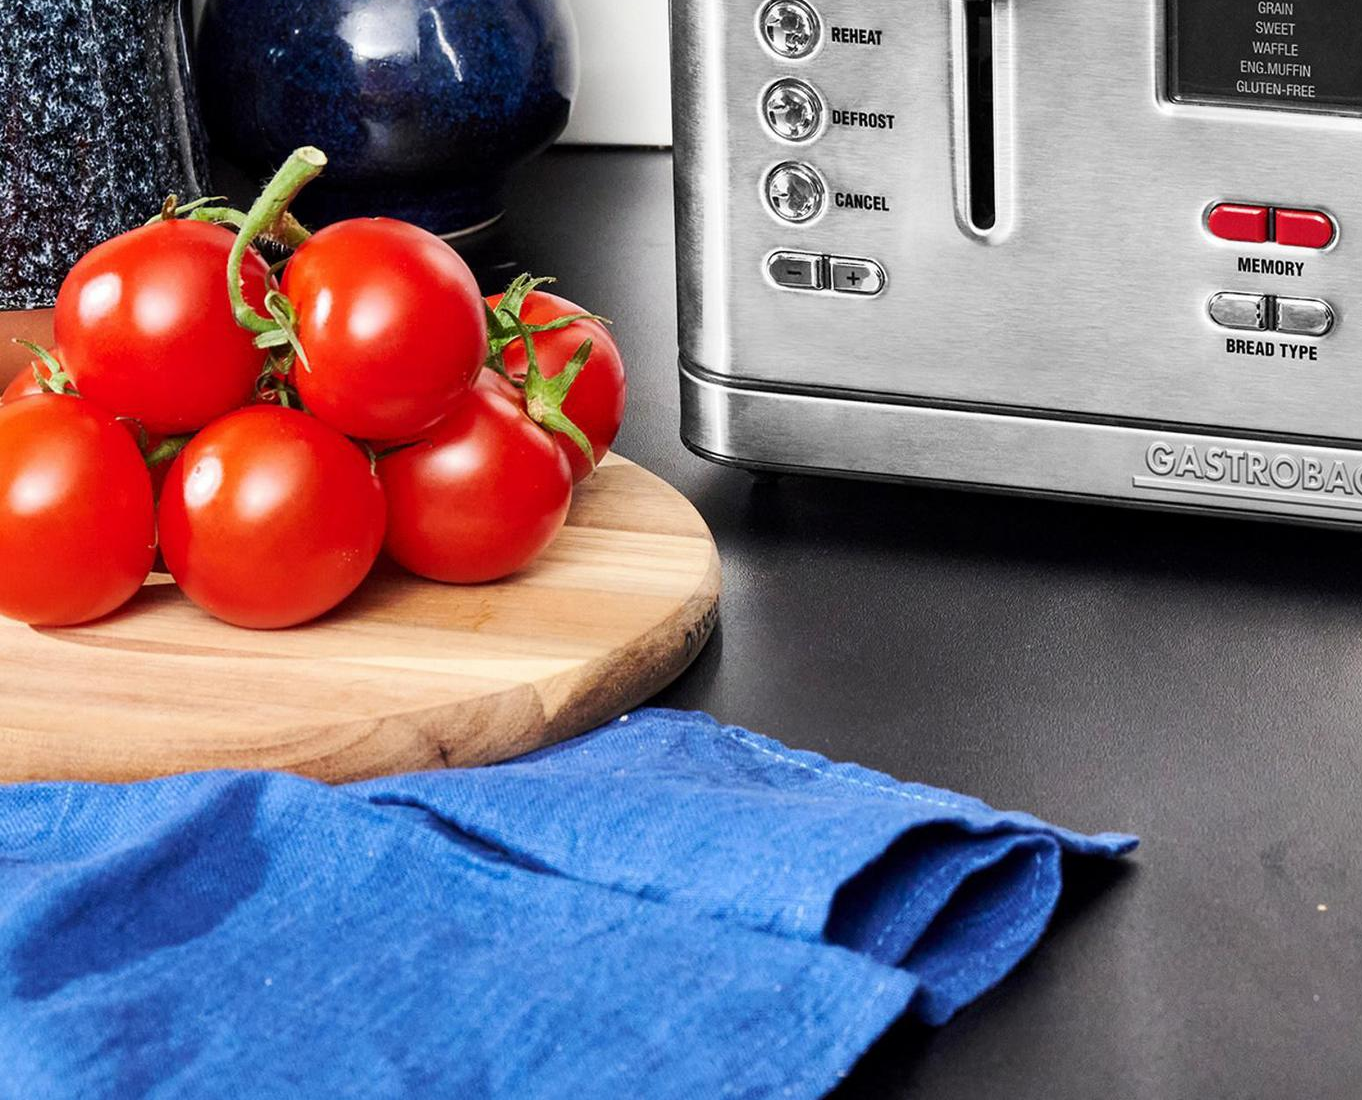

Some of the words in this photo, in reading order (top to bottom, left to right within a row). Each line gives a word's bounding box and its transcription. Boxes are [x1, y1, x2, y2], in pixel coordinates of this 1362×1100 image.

[1257, 1, 1293, 16] GRAIN
[831, 26, 883, 45] REHEAT
[1255, 21, 1296, 36] SWEET
[1252, 41, 1299, 57] WAFFLE
[1240, 60, 1311, 78] ENG.MUFFIN
[1236, 80, 1316, 98] GLUTEN-FREE
[832, 109, 895, 129] DEFROST
[834, 192, 890, 212] CANCEL
[1237, 257, 1304, 277] MEMORY
[1226, 338, 1275, 357] BREAD
[1279, 343, 1318, 361] TYPE
